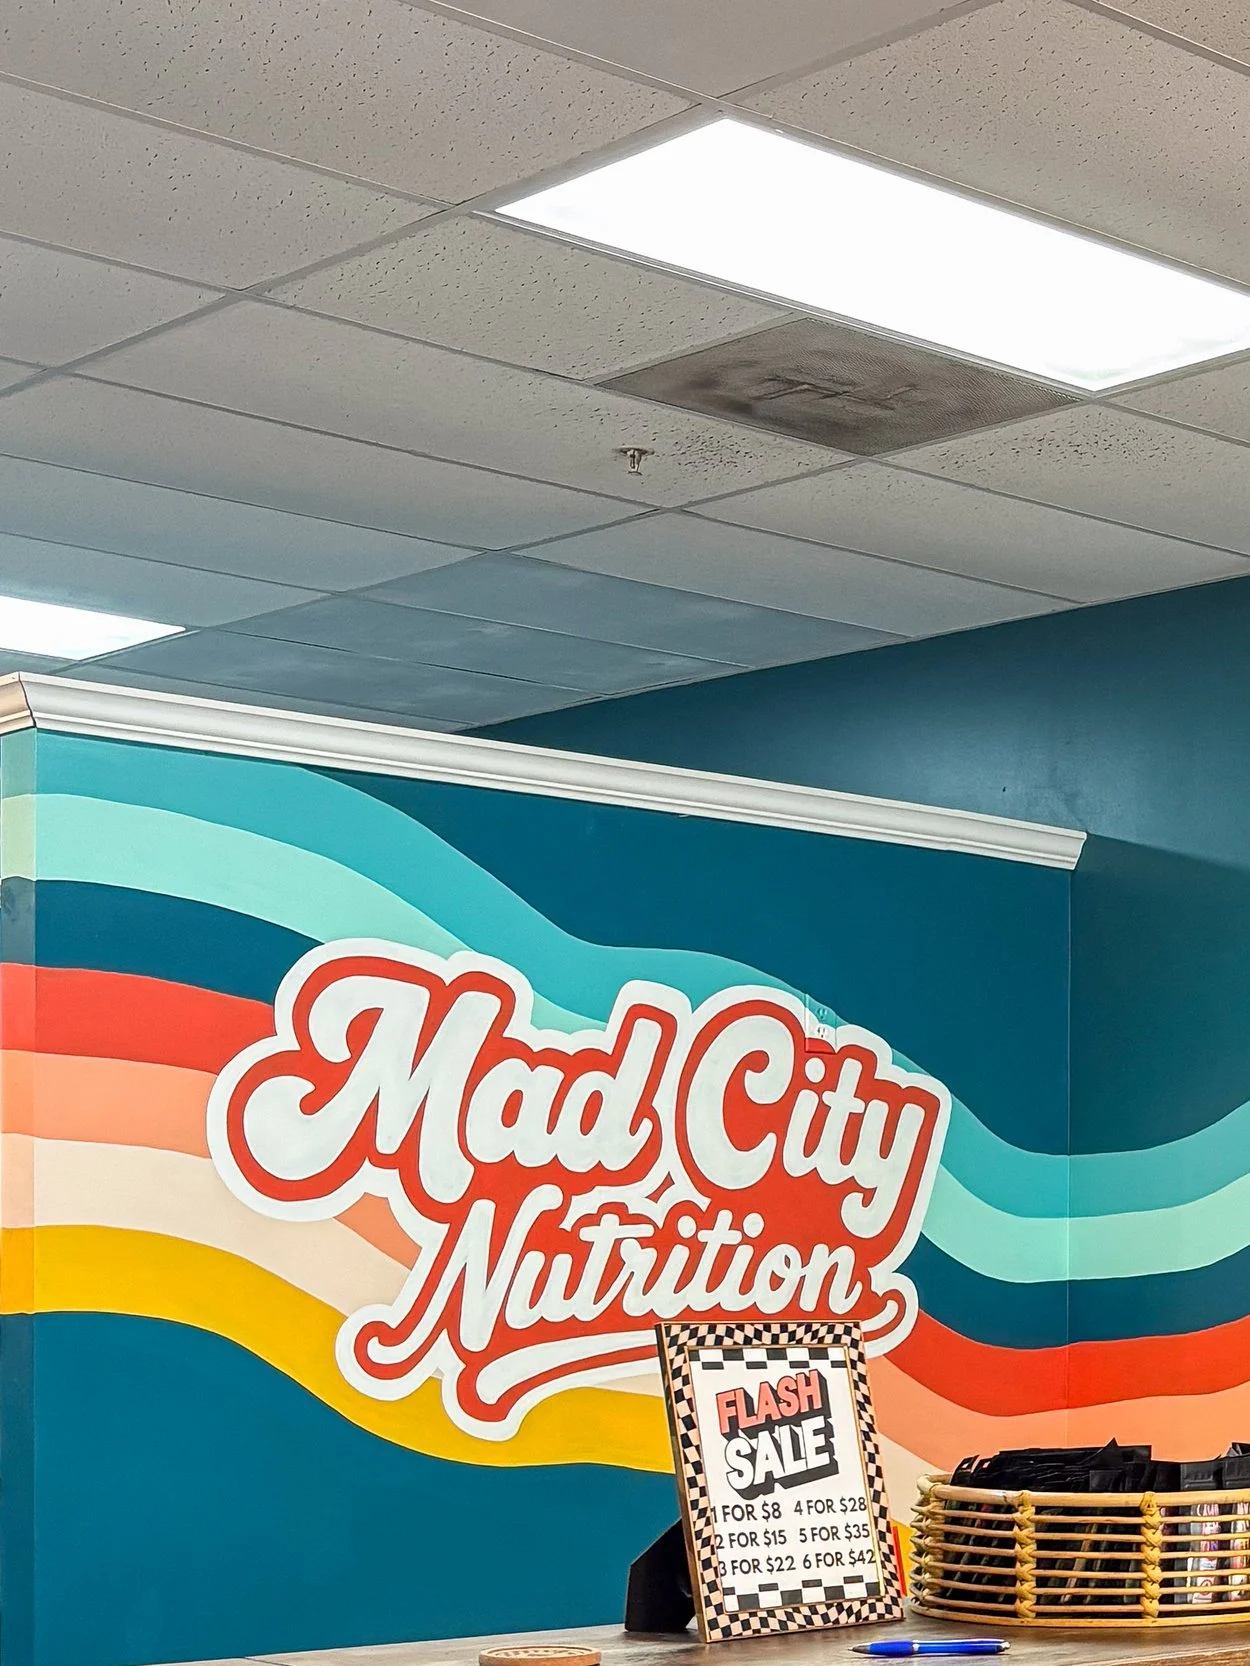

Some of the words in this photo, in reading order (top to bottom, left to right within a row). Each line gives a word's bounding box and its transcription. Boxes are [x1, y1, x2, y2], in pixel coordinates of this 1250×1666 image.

[242, 973, 655, 1203] Mad
[685, 1020, 926, 1238] City
[366, 1183, 866, 1352] Nutrition
[716, 1368, 824, 1434] FLASH
[724, 1415, 834, 1491] SALE
[710, 1505, 718, 1523] 1
[721, 1503, 758, 1523] FOR
[761, 1500, 782, 1522] $8
[793, 1500, 803, 1515] 4
[806, 1498, 837, 1515] FOR
[839, 1496, 867, 1515] $28
[714, 1534, 725, 1549] 2
[728, 1531, 760, 1548] FOR
[763, 1528, 787, 1548] $15
[799, 1527, 808, 1543] 5
[810, 1525, 841, 1542] FOR
[844, 1522, 870, 1542] $35
[718, 1561, 728, 1577] 3
[730, 1558, 763, 1576] FOR
[766, 1555, 797, 1575] $22
[802, 1553, 812, 1570] 6
[815, 1551, 846, 1569] FOR
[848, 1548, 877, 1568] $42
